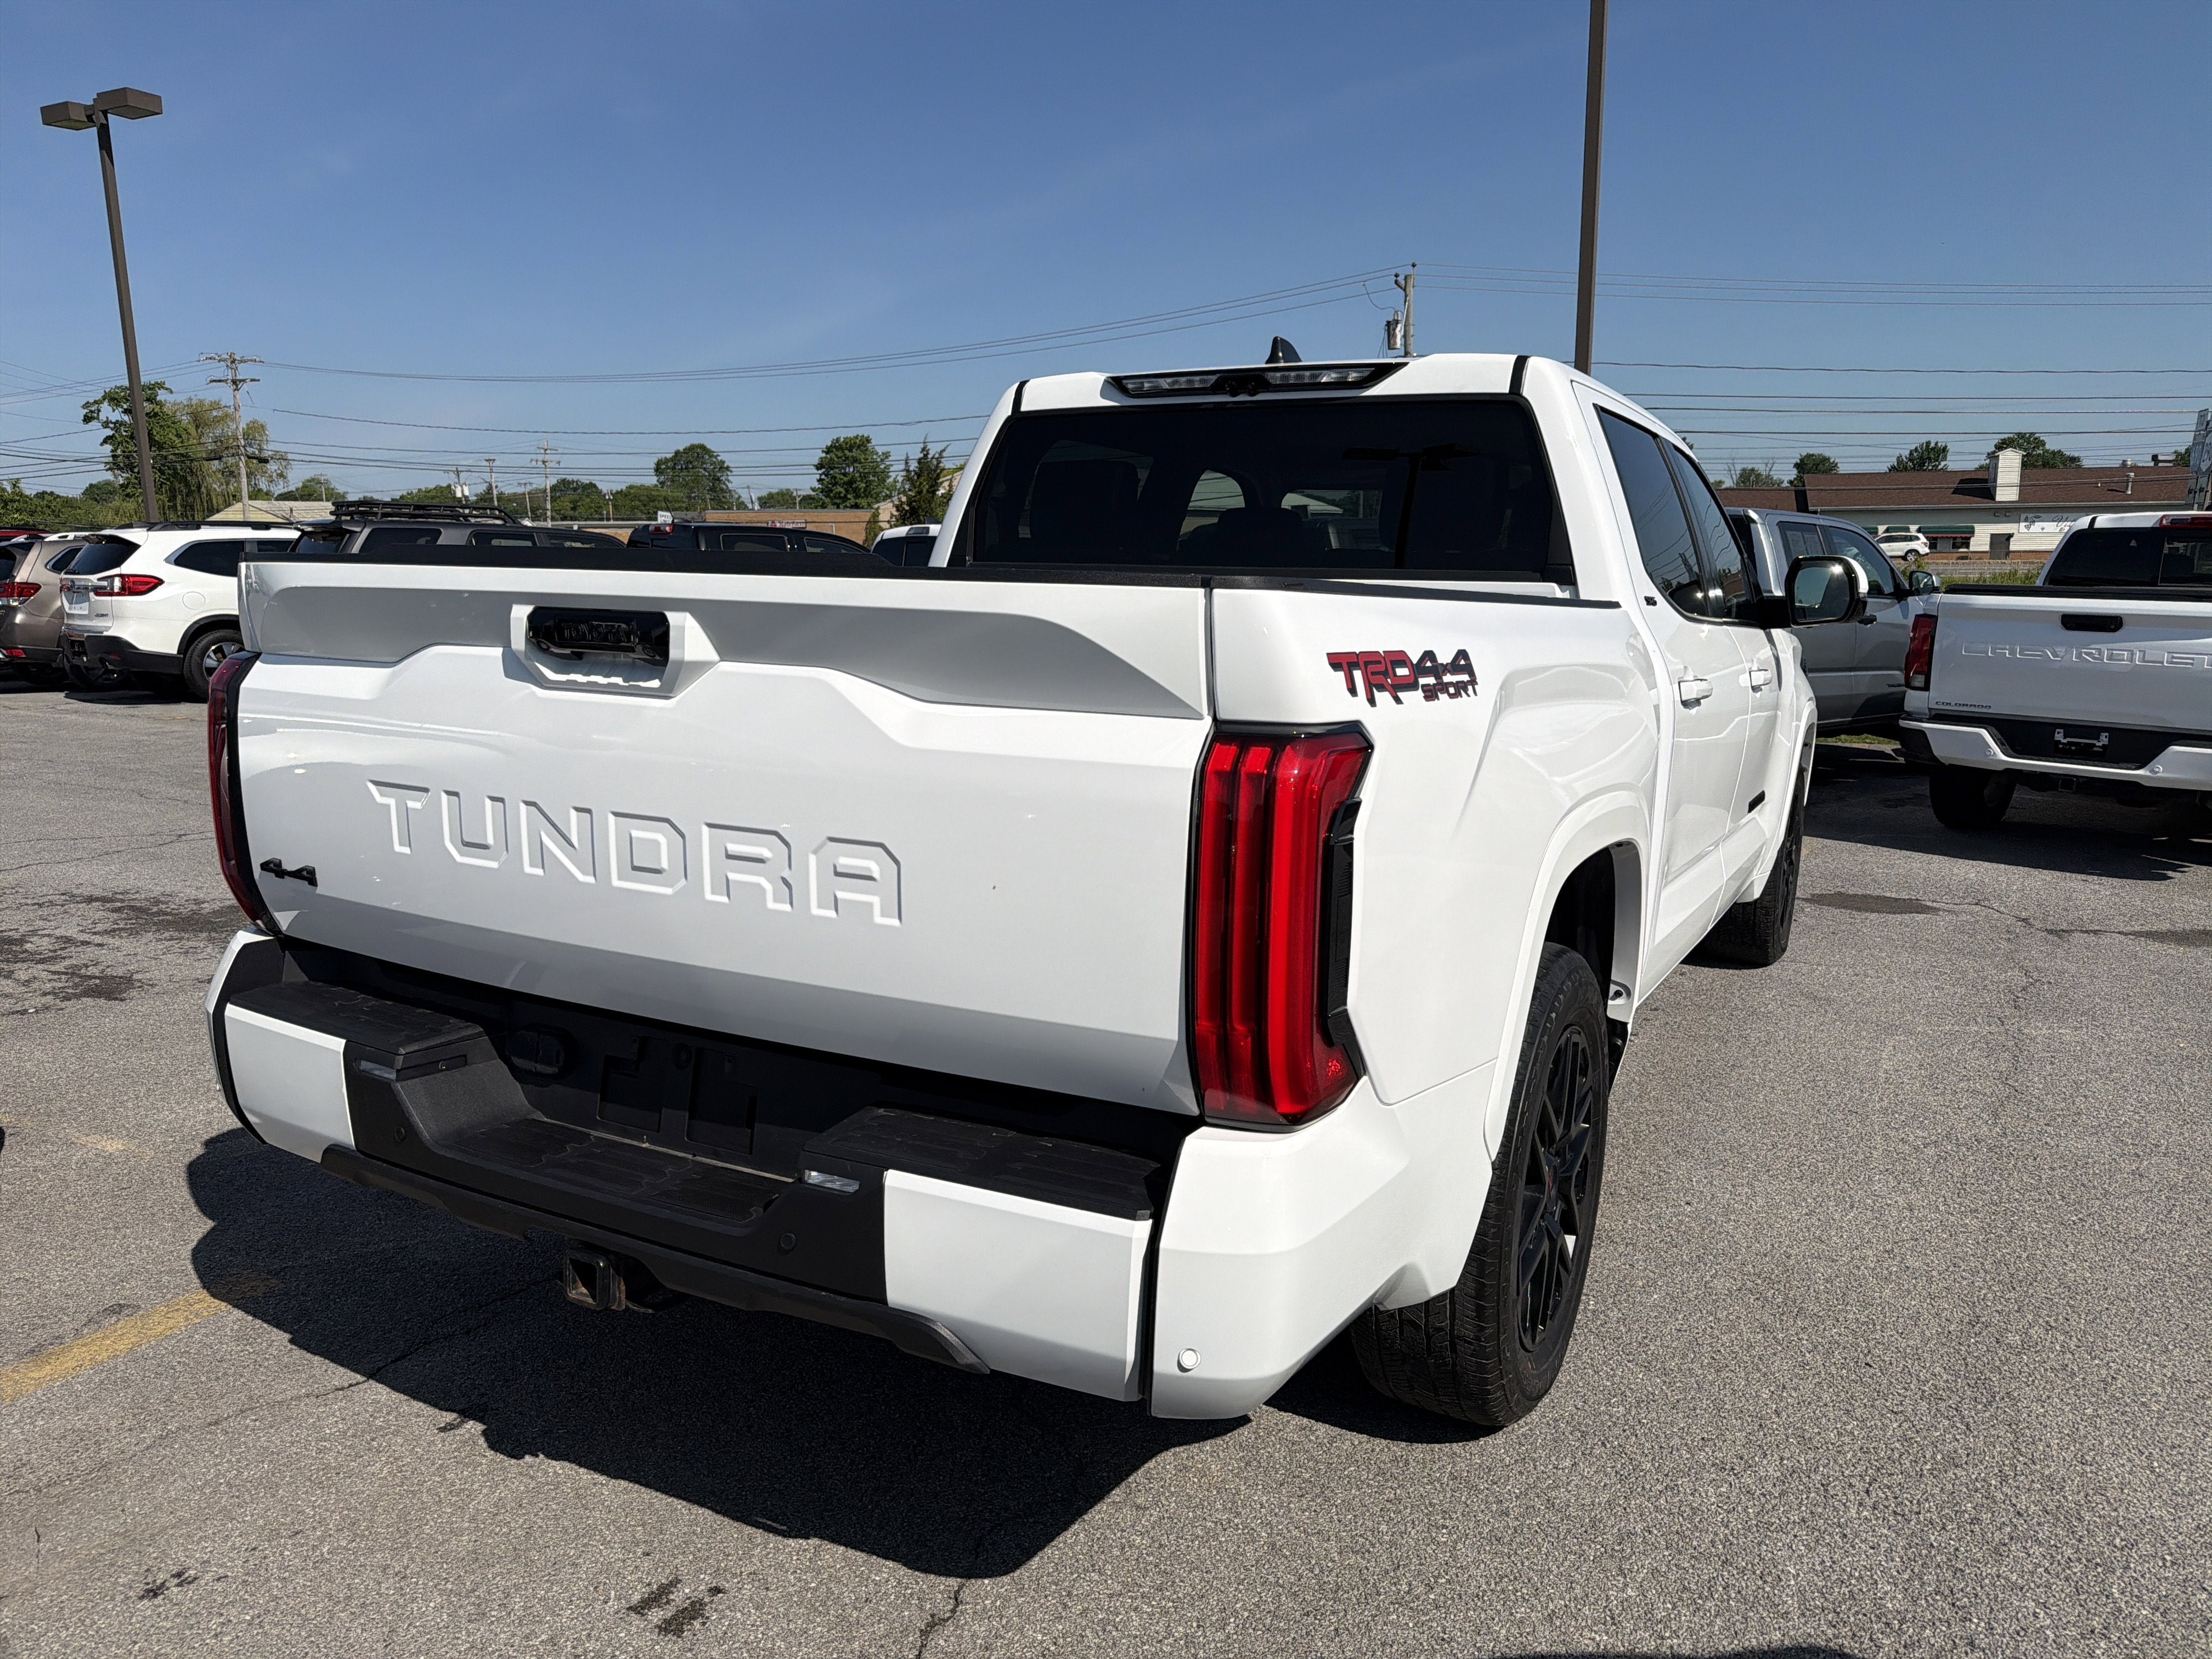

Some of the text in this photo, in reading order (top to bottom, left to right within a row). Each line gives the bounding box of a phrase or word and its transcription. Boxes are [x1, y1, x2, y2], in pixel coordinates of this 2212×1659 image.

[1326, 650, 1419, 708] TRD
[1420, 680, 1479, 702] SPORT
[1936, 701, 1991, 709] COLORADO
[367, 780, 902, 927] TUNDRA
